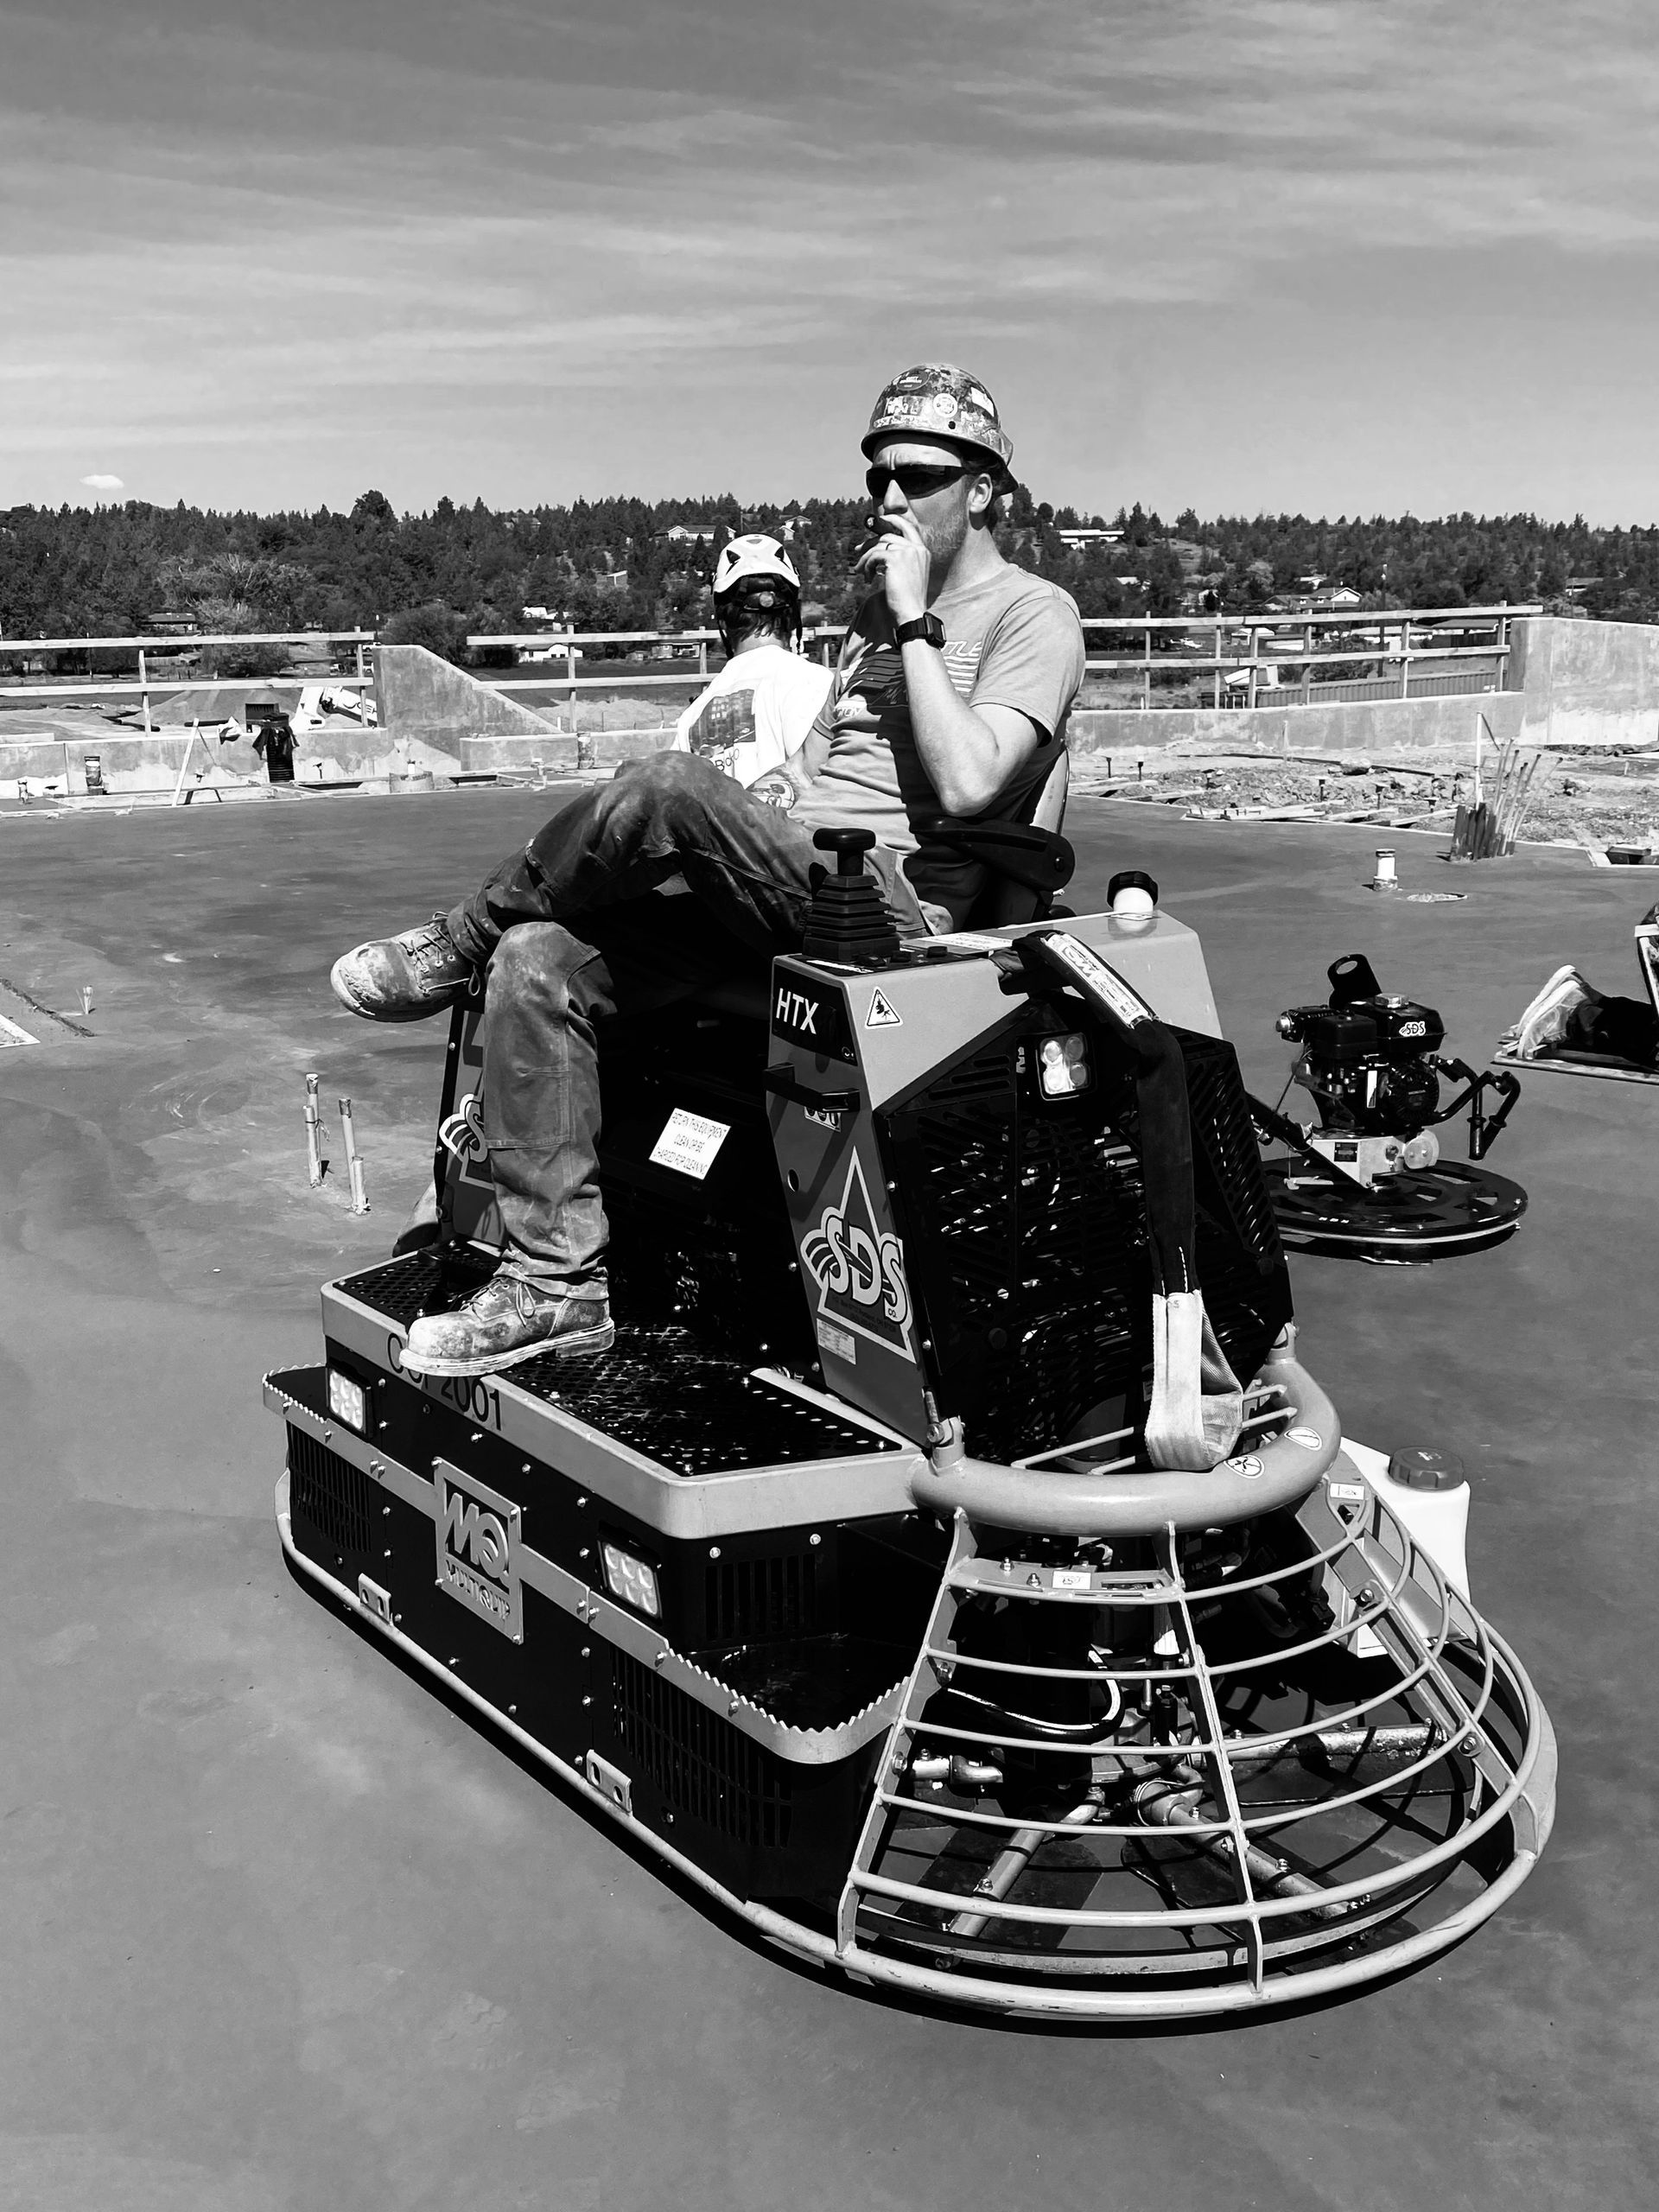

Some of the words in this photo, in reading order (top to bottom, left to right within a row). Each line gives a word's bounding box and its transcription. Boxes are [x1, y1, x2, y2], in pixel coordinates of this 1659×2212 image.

[776, 988, 819, 1034] HTX
[1406, 1021, 1426, 1035] SDS
[827, 1214, 907, 1323] SDS
[442, 1488, 510, 1588] MQ
